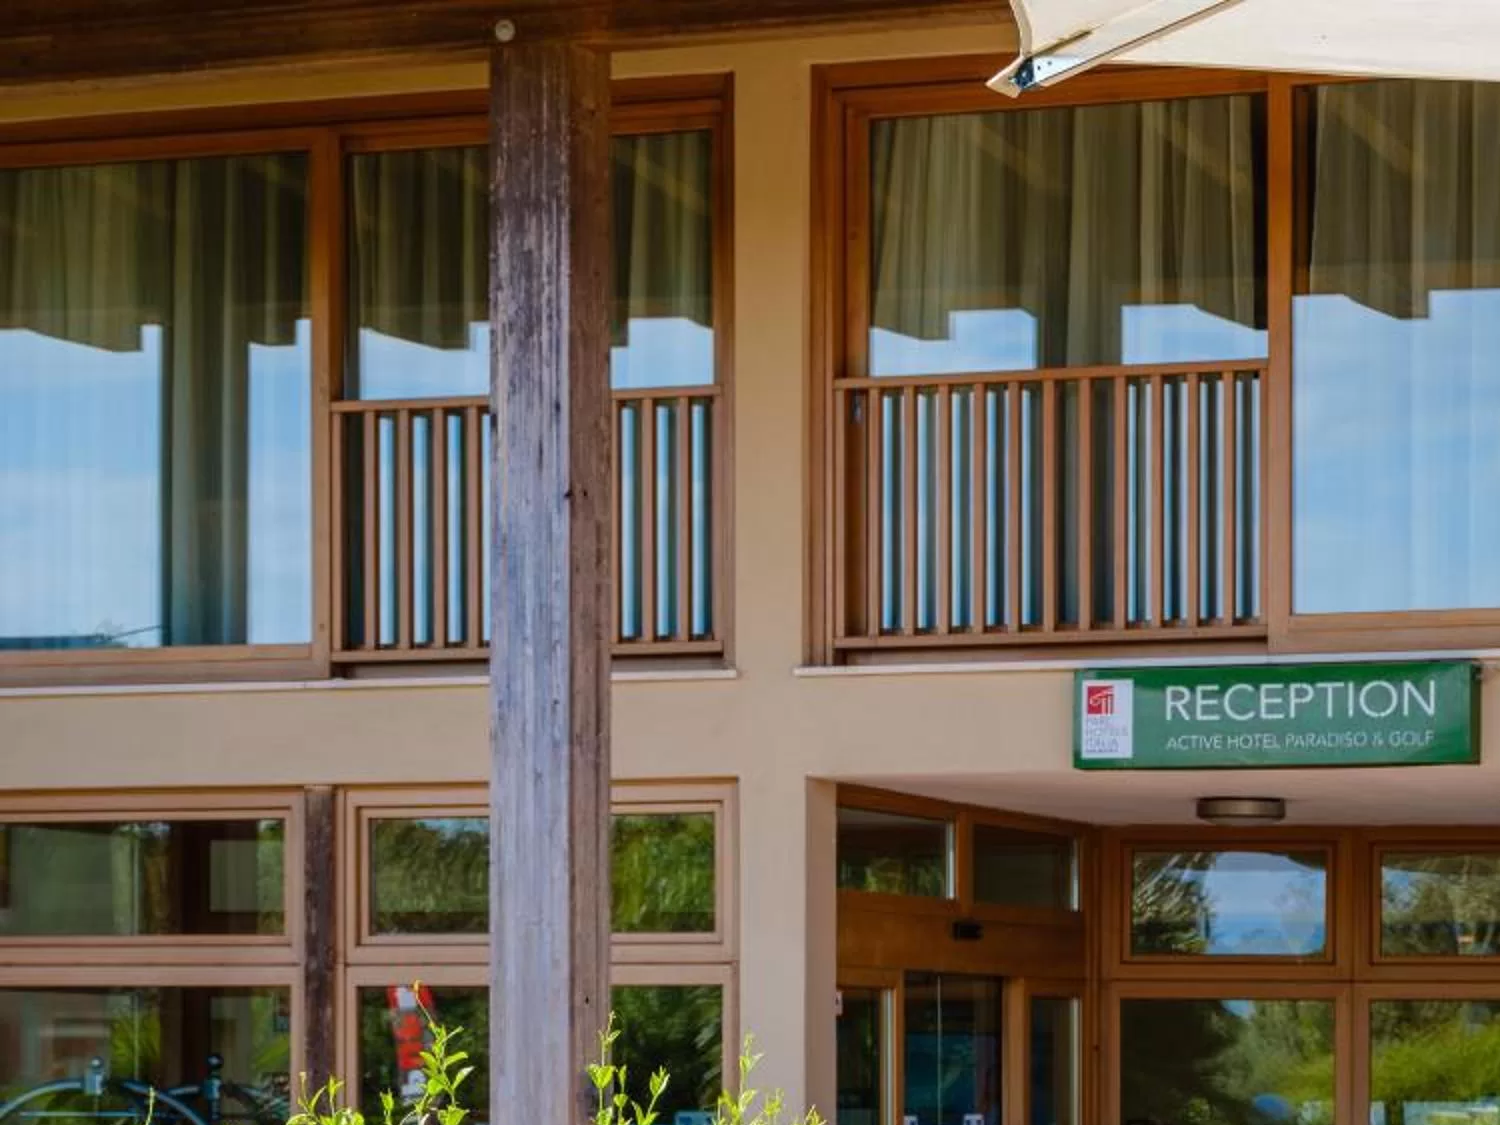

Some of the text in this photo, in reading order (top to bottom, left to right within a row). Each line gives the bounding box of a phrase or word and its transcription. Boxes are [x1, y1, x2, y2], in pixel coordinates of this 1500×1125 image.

[1166, 681, 1436, 720] RECEPTION
[1166, 734, 1222, 750] ACTIVE
[1227, 733, 1280, 750] HOTEL
[1284, 731, 1368, 749] PARADISO
[1388, 729, 1435, 746] GOLF
